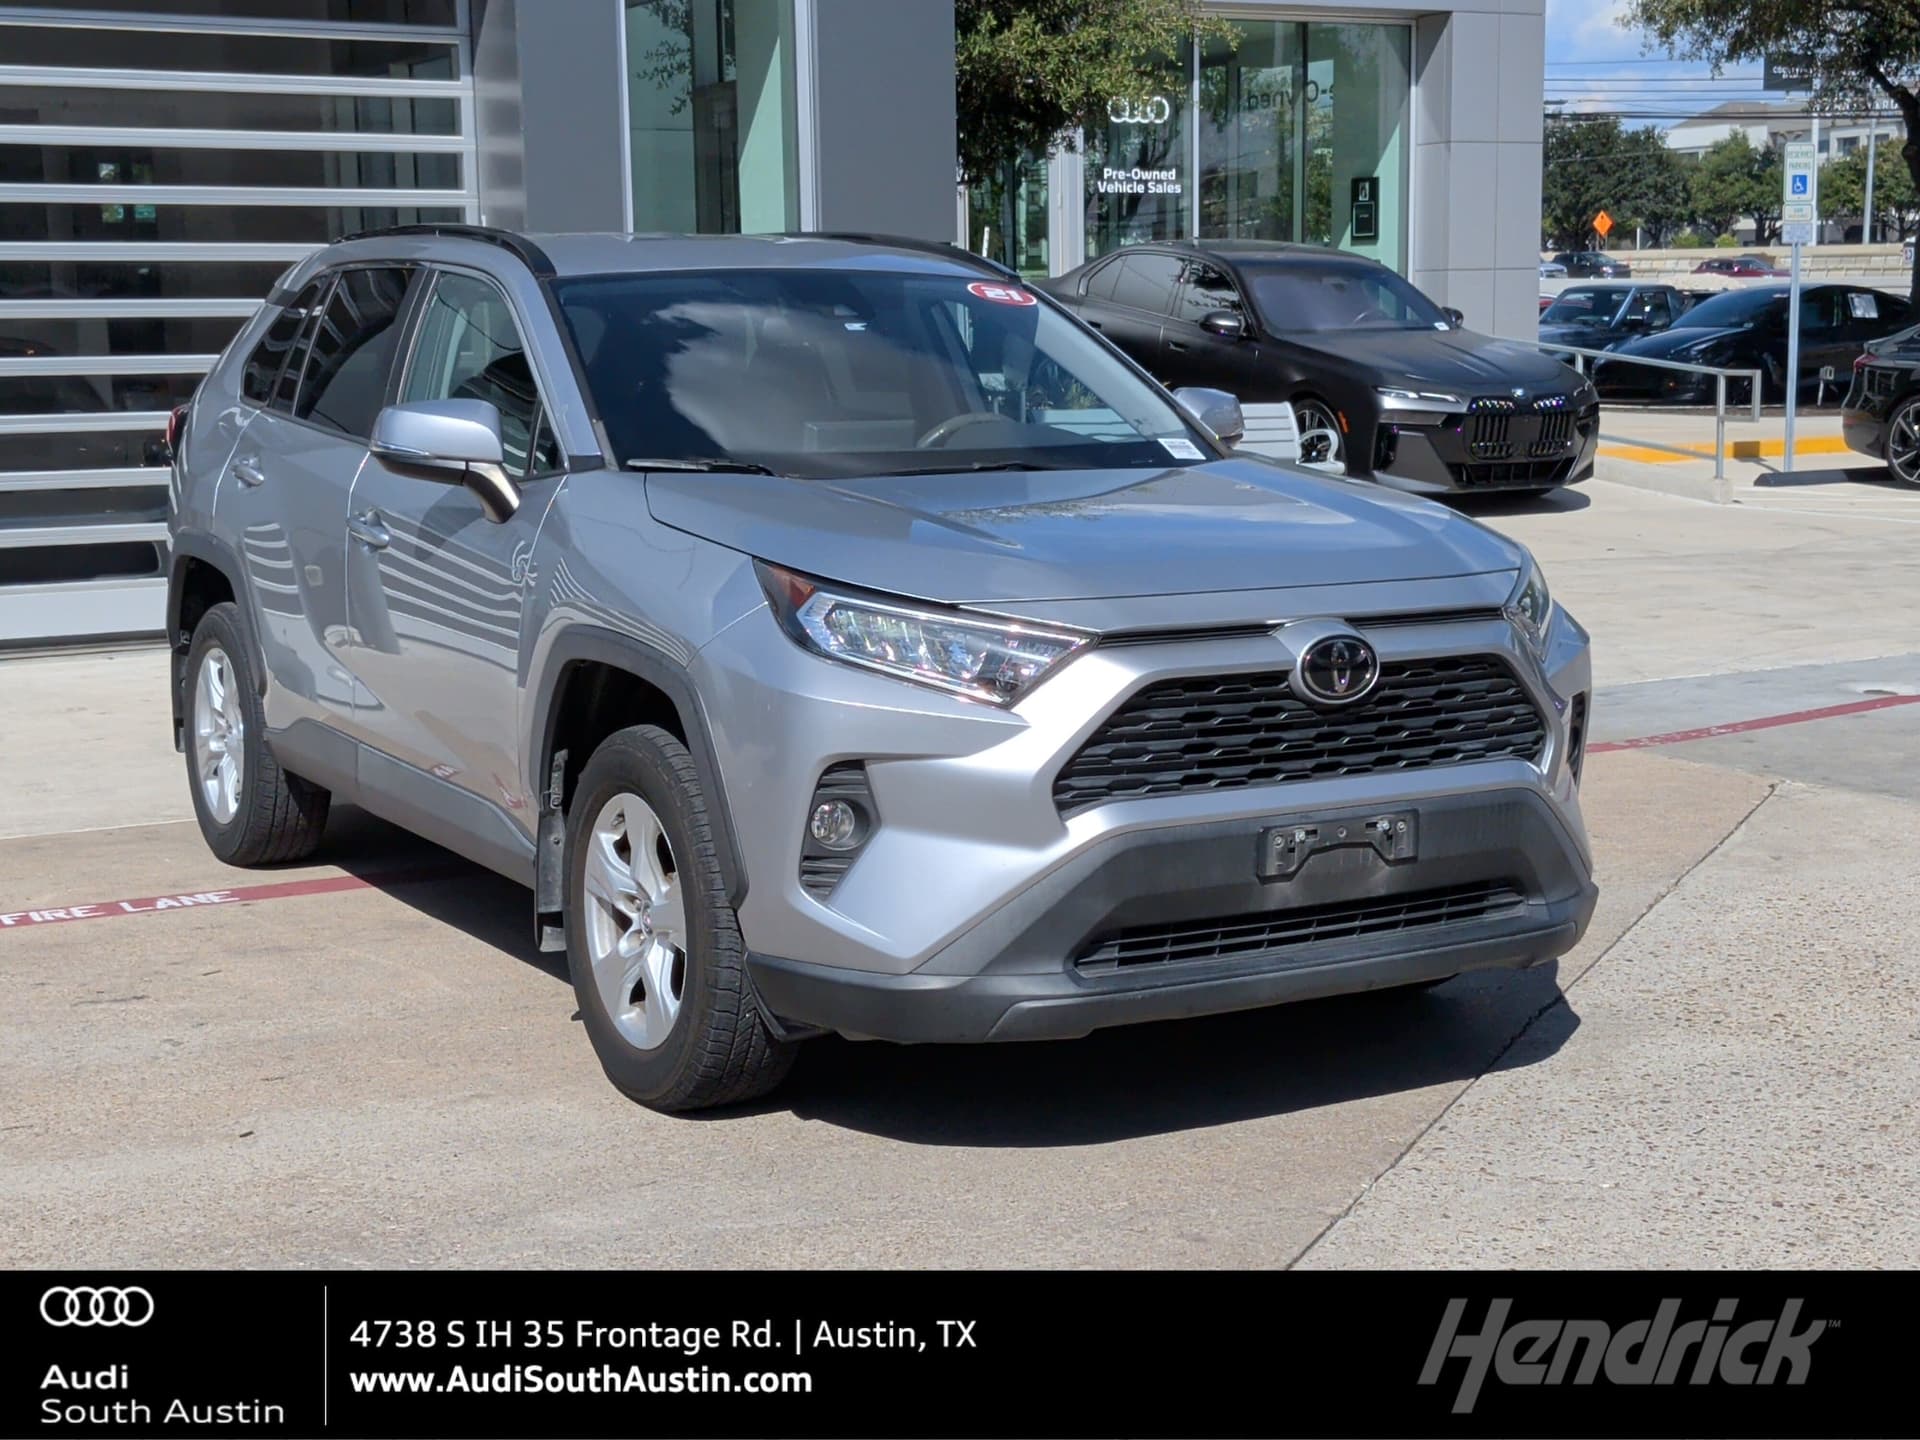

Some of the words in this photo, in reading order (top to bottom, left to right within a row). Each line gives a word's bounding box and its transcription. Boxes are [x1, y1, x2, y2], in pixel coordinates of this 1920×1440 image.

[1103, 167, 1176, 180] Pre-Owned
[1097, 181, 1145, 193] Vehicle
[1147, 181, 1182, 193] Sales
[980, 285, 1024, 302] 21
[1, 904, 105, 926] FIRE
[119, 890, 241, 912] LANE
